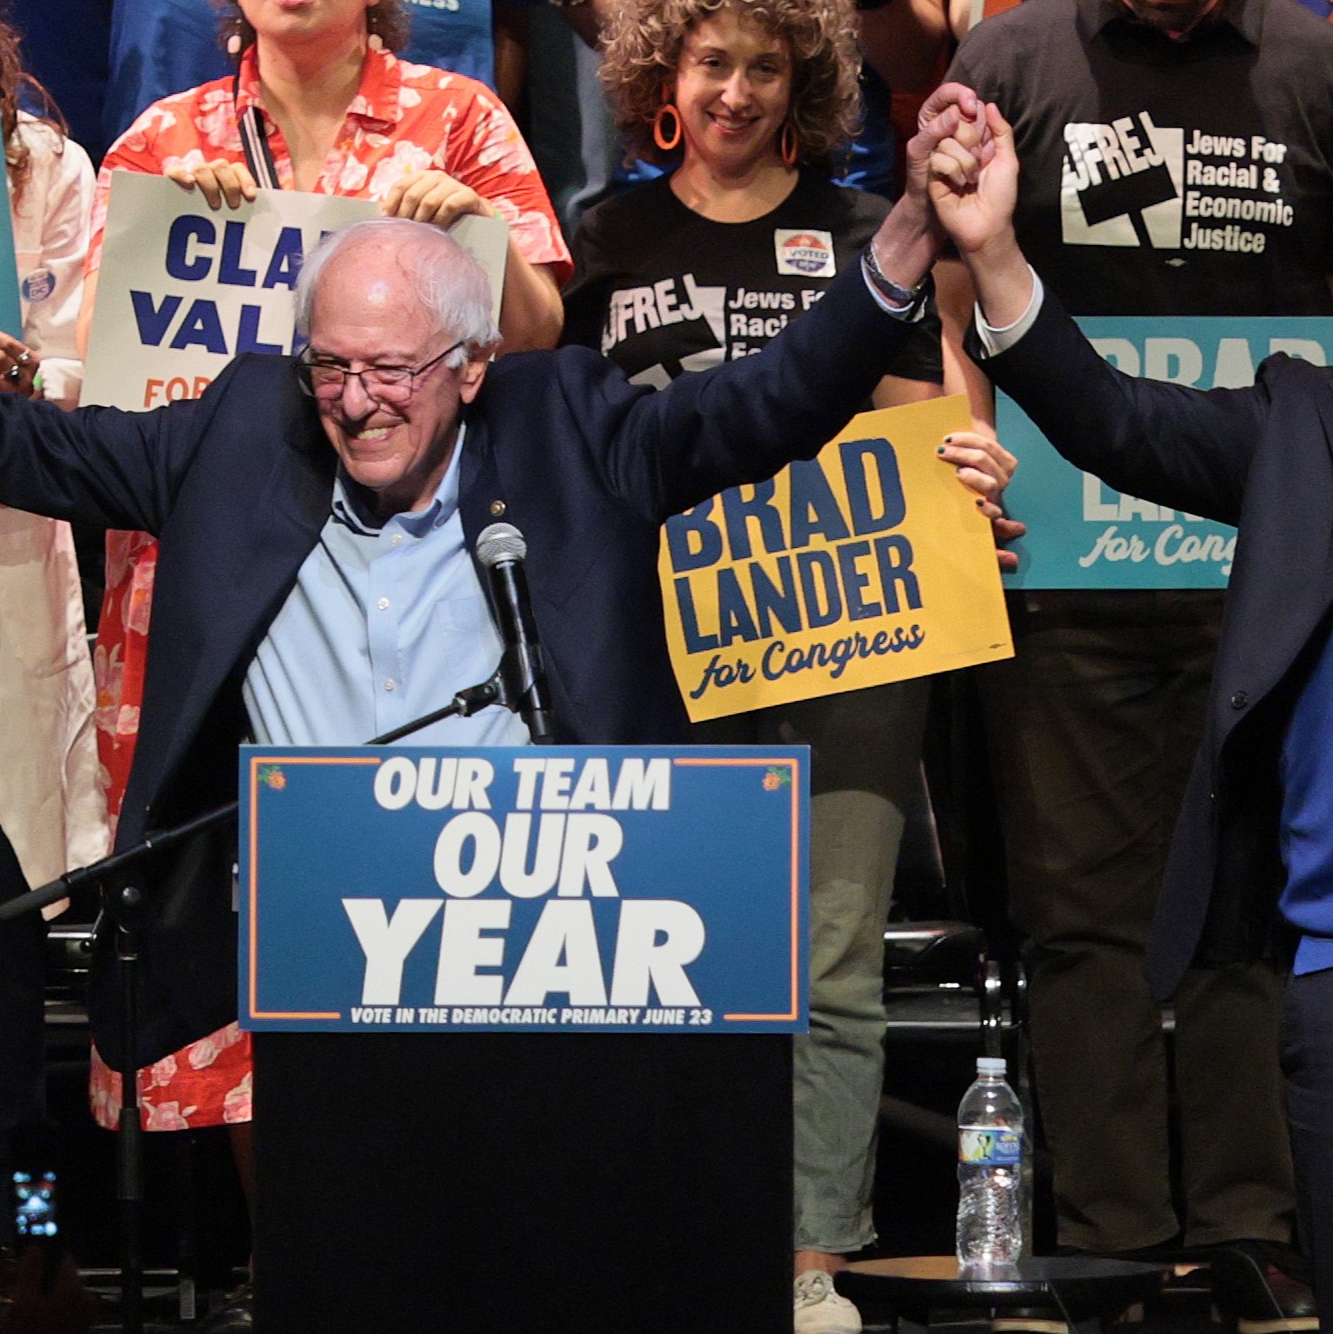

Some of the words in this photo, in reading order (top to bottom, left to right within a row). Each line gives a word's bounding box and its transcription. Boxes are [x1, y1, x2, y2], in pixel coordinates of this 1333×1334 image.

[1063, 110, 1166, 192] JFREJ
[1186, 129, 1246, 158] Jews
[1250, 135, 1288, 164] For
[1186, 159, 1258, 190] Racial
[1262, 167, 1281, 194] &
[1185, 190, 1294, 227] Economic
[789, 249, 829, 260] VOTED
[1183, 222, 1266, 254] Justice
[601, 273, 705, 358] JFREJ
[728, 287, 796, 311] Jews
[667, 437, 907, 574] BRAD
[1078, 525, 1151, 567] for
[673, 533, 923, 656] LANDER
[688, 653, 756, 700] for
[761, 623, 926, 679] Congress
[372, 755, 495, 811] OUR
[512, 757, 671, 811] TEAM
[432, 811, 624, 899] OUR
[340, 898, 707, 1007] YEAR
[351, 1007, 393, 1024] VOTE
[395, 1008, 415, 1024] IN
[418, 1008, 449, 1024] THE
[451, 1007, 558, 1025] DEMOCRATIC
[560, 1008, 641, 1025] PRIMARY
[642, 1009, 687, 1026] JUNE
[688, 1009, 713, 1026] 23
